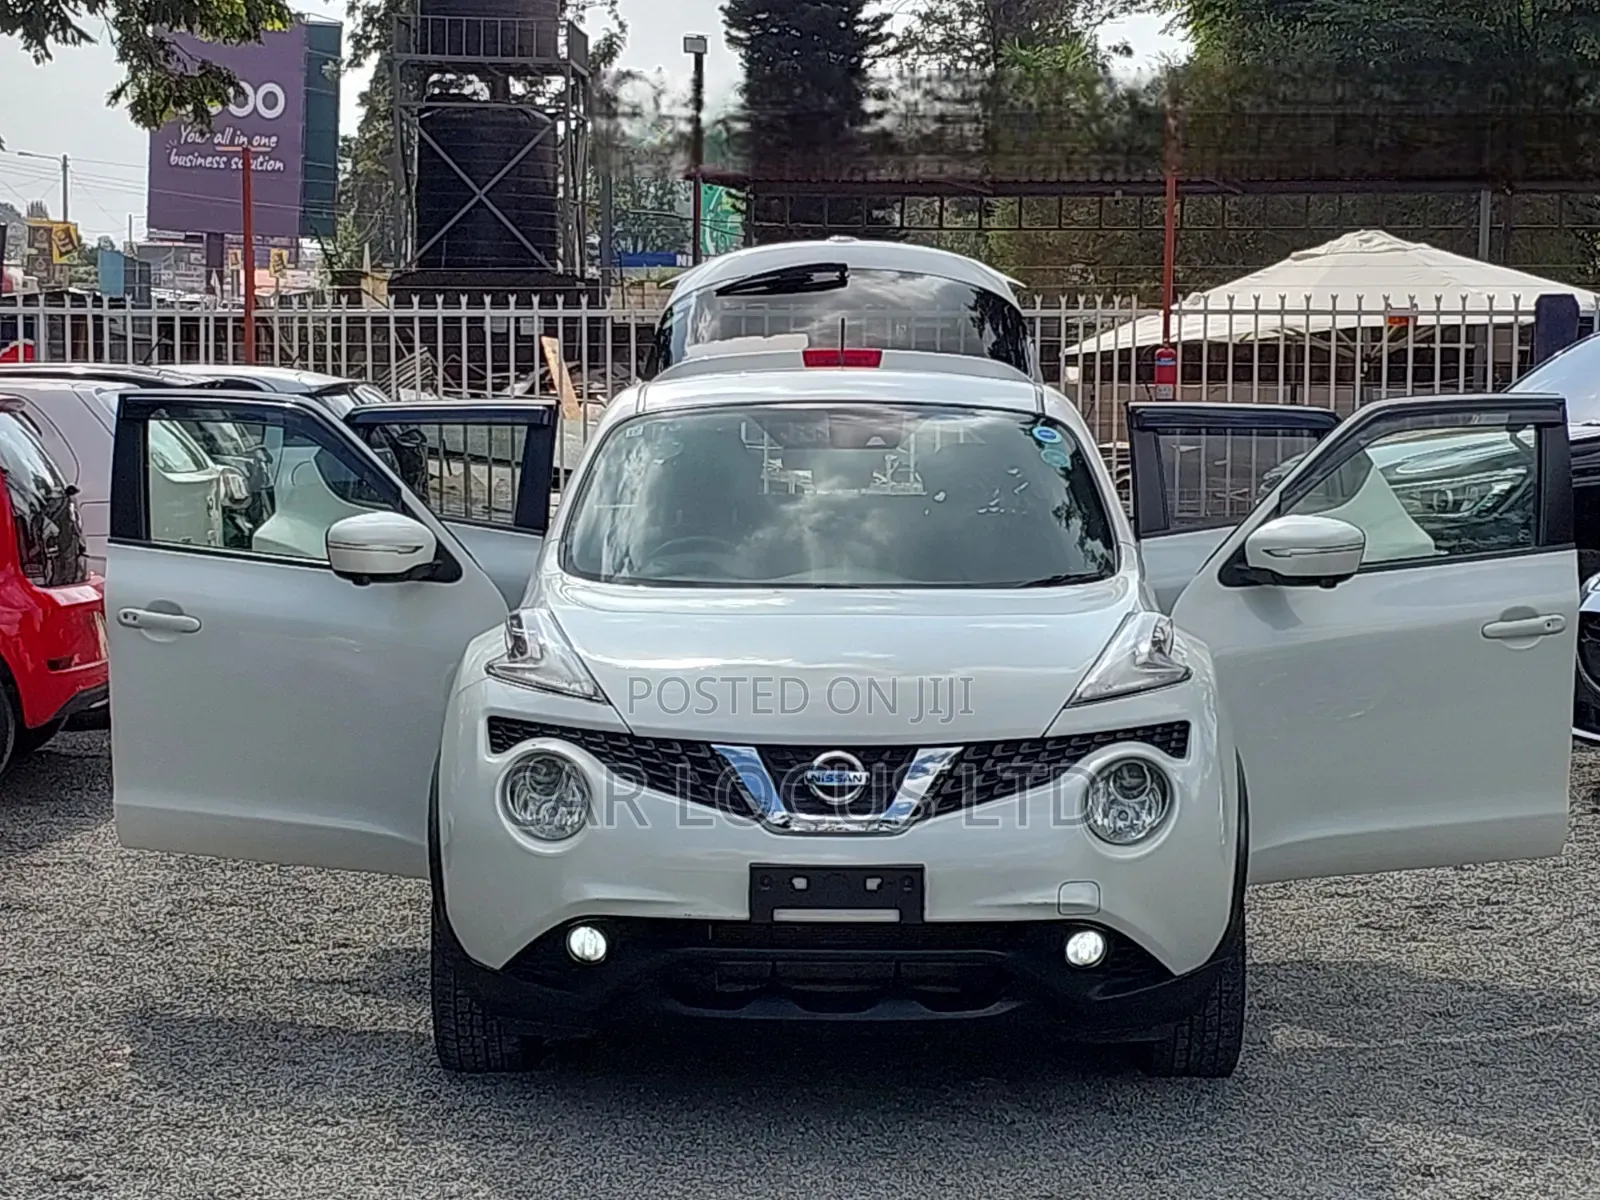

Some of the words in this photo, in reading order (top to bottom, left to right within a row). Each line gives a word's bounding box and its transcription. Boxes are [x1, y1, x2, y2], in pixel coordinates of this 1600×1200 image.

[180, 124, 210, 144] Your
[214, 127, 233, 145] all
[234, 130, 248, 147] in
[252, 135, 278, 147] one
[170, 148, 228, 169] business
[231, 154, 284, 171] soution
[809, 772, 864, 784] NISSAN
